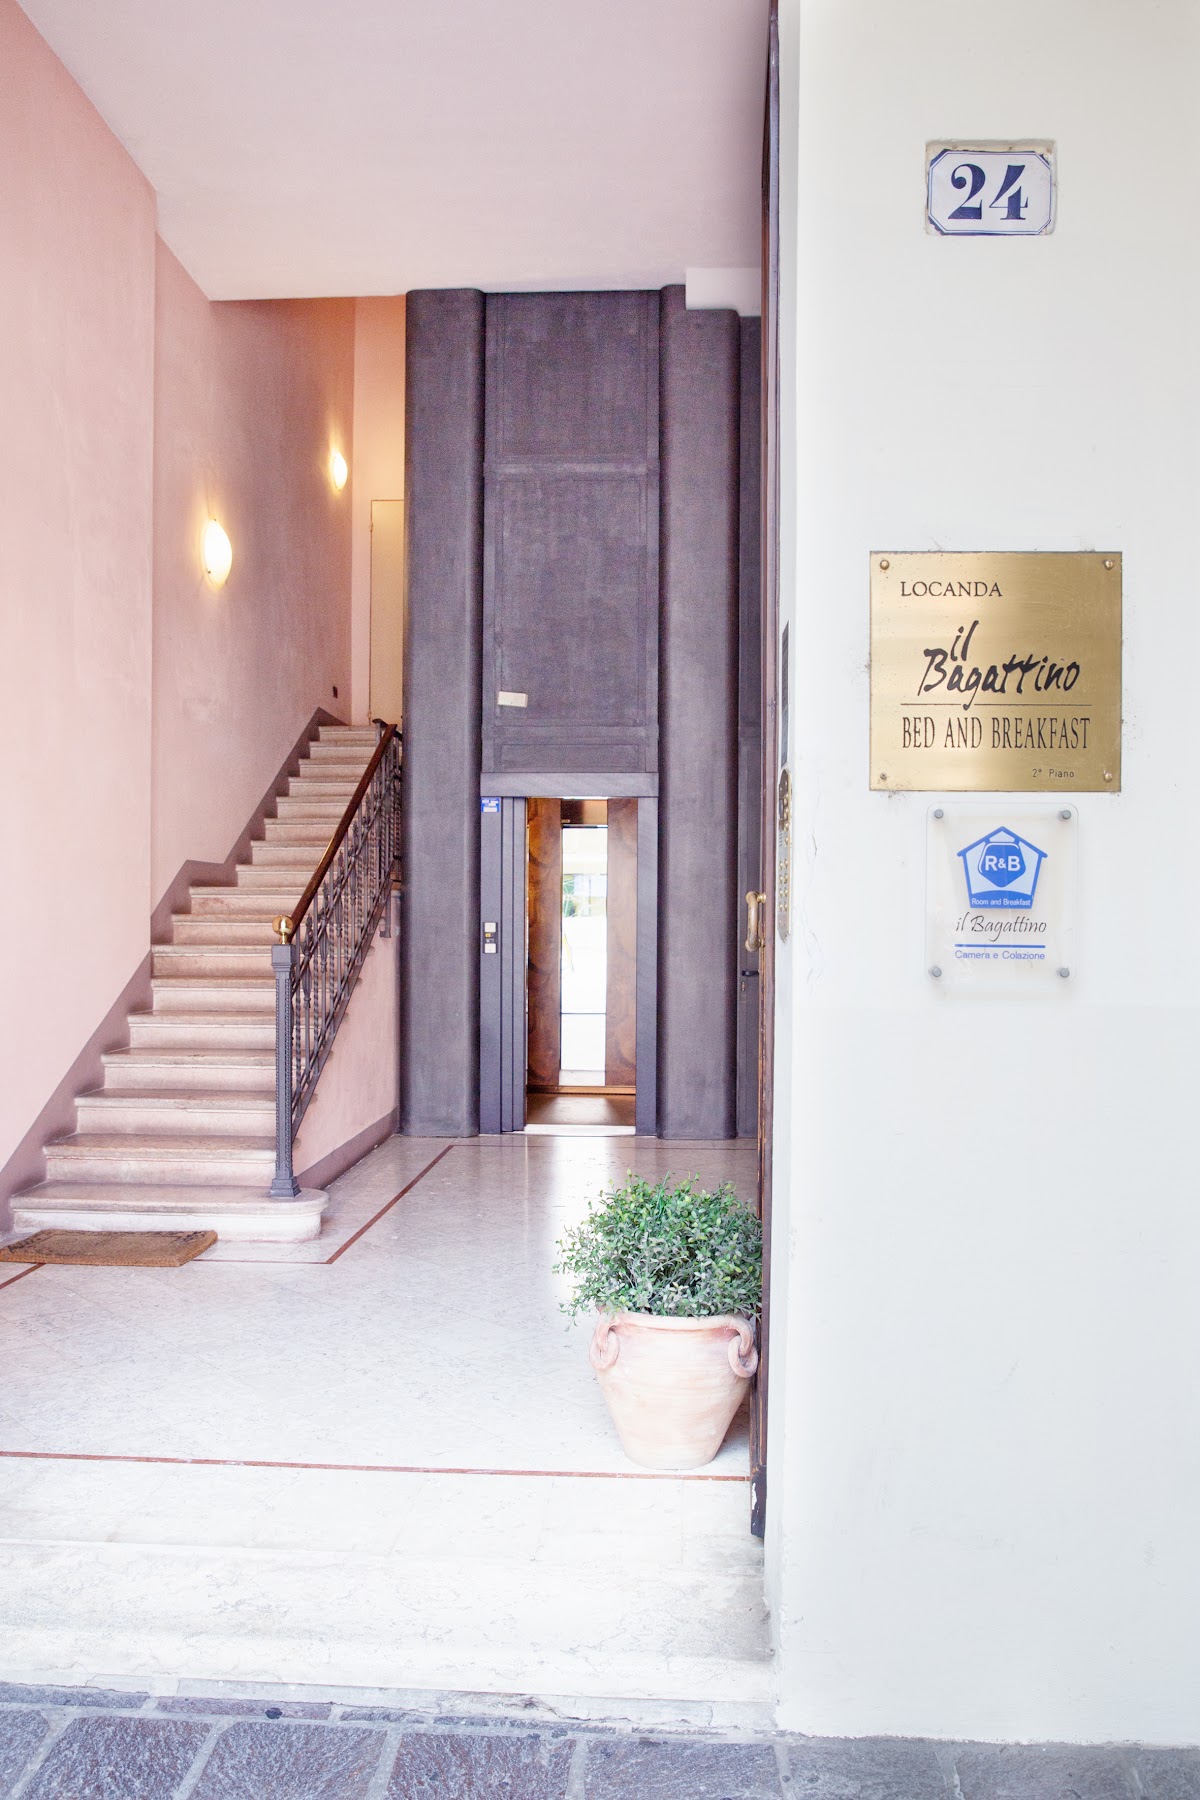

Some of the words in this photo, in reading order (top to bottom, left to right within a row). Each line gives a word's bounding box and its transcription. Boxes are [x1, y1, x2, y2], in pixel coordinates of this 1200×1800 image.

[947, 163, 1029, 221] 24
[900, 581, 1003, 598] LOCANDA
[950, 620, 979, 662] il
[917, 648, 1080, 711] Bagattino
[902, 716, 936, 749] BED
[944, 717, 983, 749] AND
[991, 717, 1091, 749] BREAKFAST
[1048, 768, 1075, 778] Piano
[984, 855, 1021, 872] R&B
[971, 897, 989, 906] Room
[990, 898, 1002, 906] and
[1003, 897, 1031, 906] Breakfast
[955, 911, 970, 932] il
[970, 914, 1047, 942] Bagattino
[954, 950, 991, 960] Camera
[992, 952, 999, 960] e
[1001, 950, 1046, 960] Colazione
